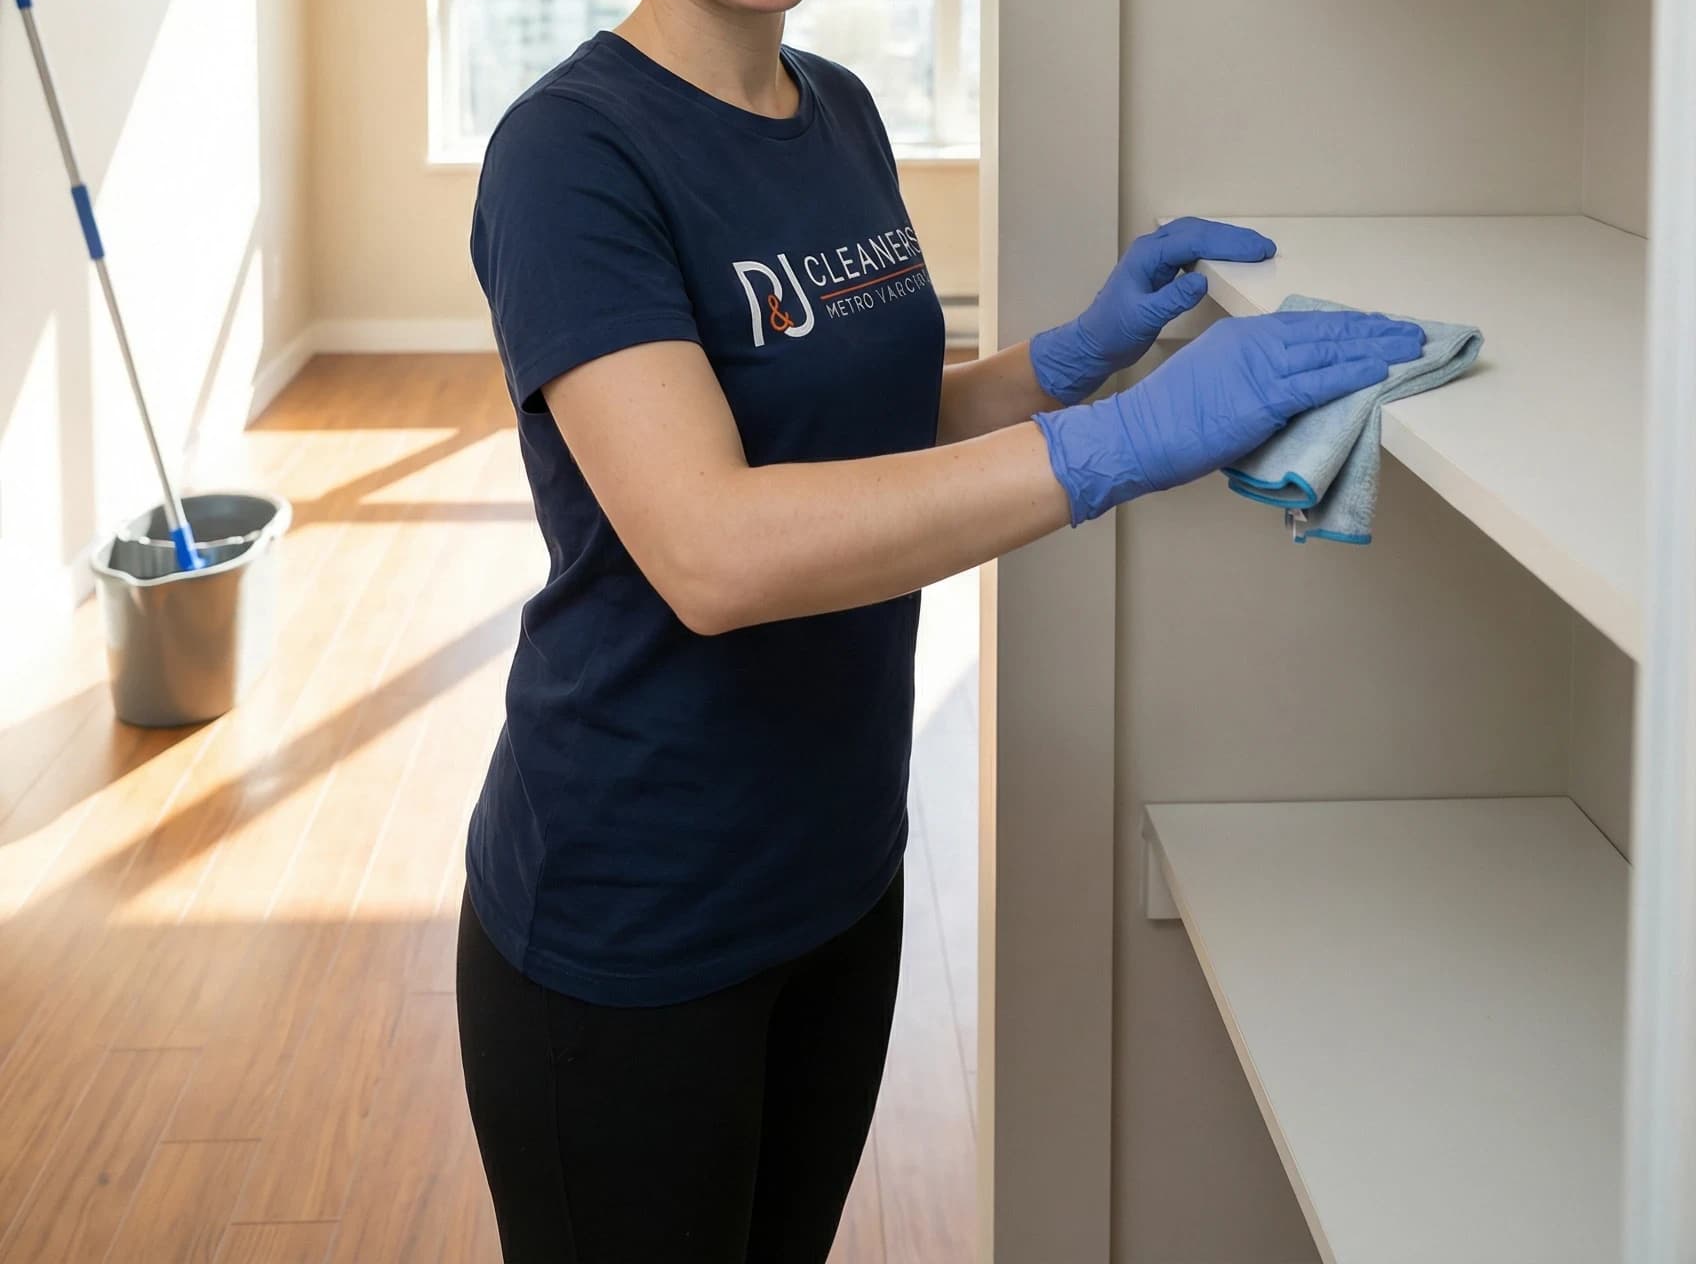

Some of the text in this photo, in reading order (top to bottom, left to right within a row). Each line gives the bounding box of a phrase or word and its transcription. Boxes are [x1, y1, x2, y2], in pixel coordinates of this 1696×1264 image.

[732, 226, 921, 347] P&J CLEANERS
[825, 292, 874, 319] METRO
